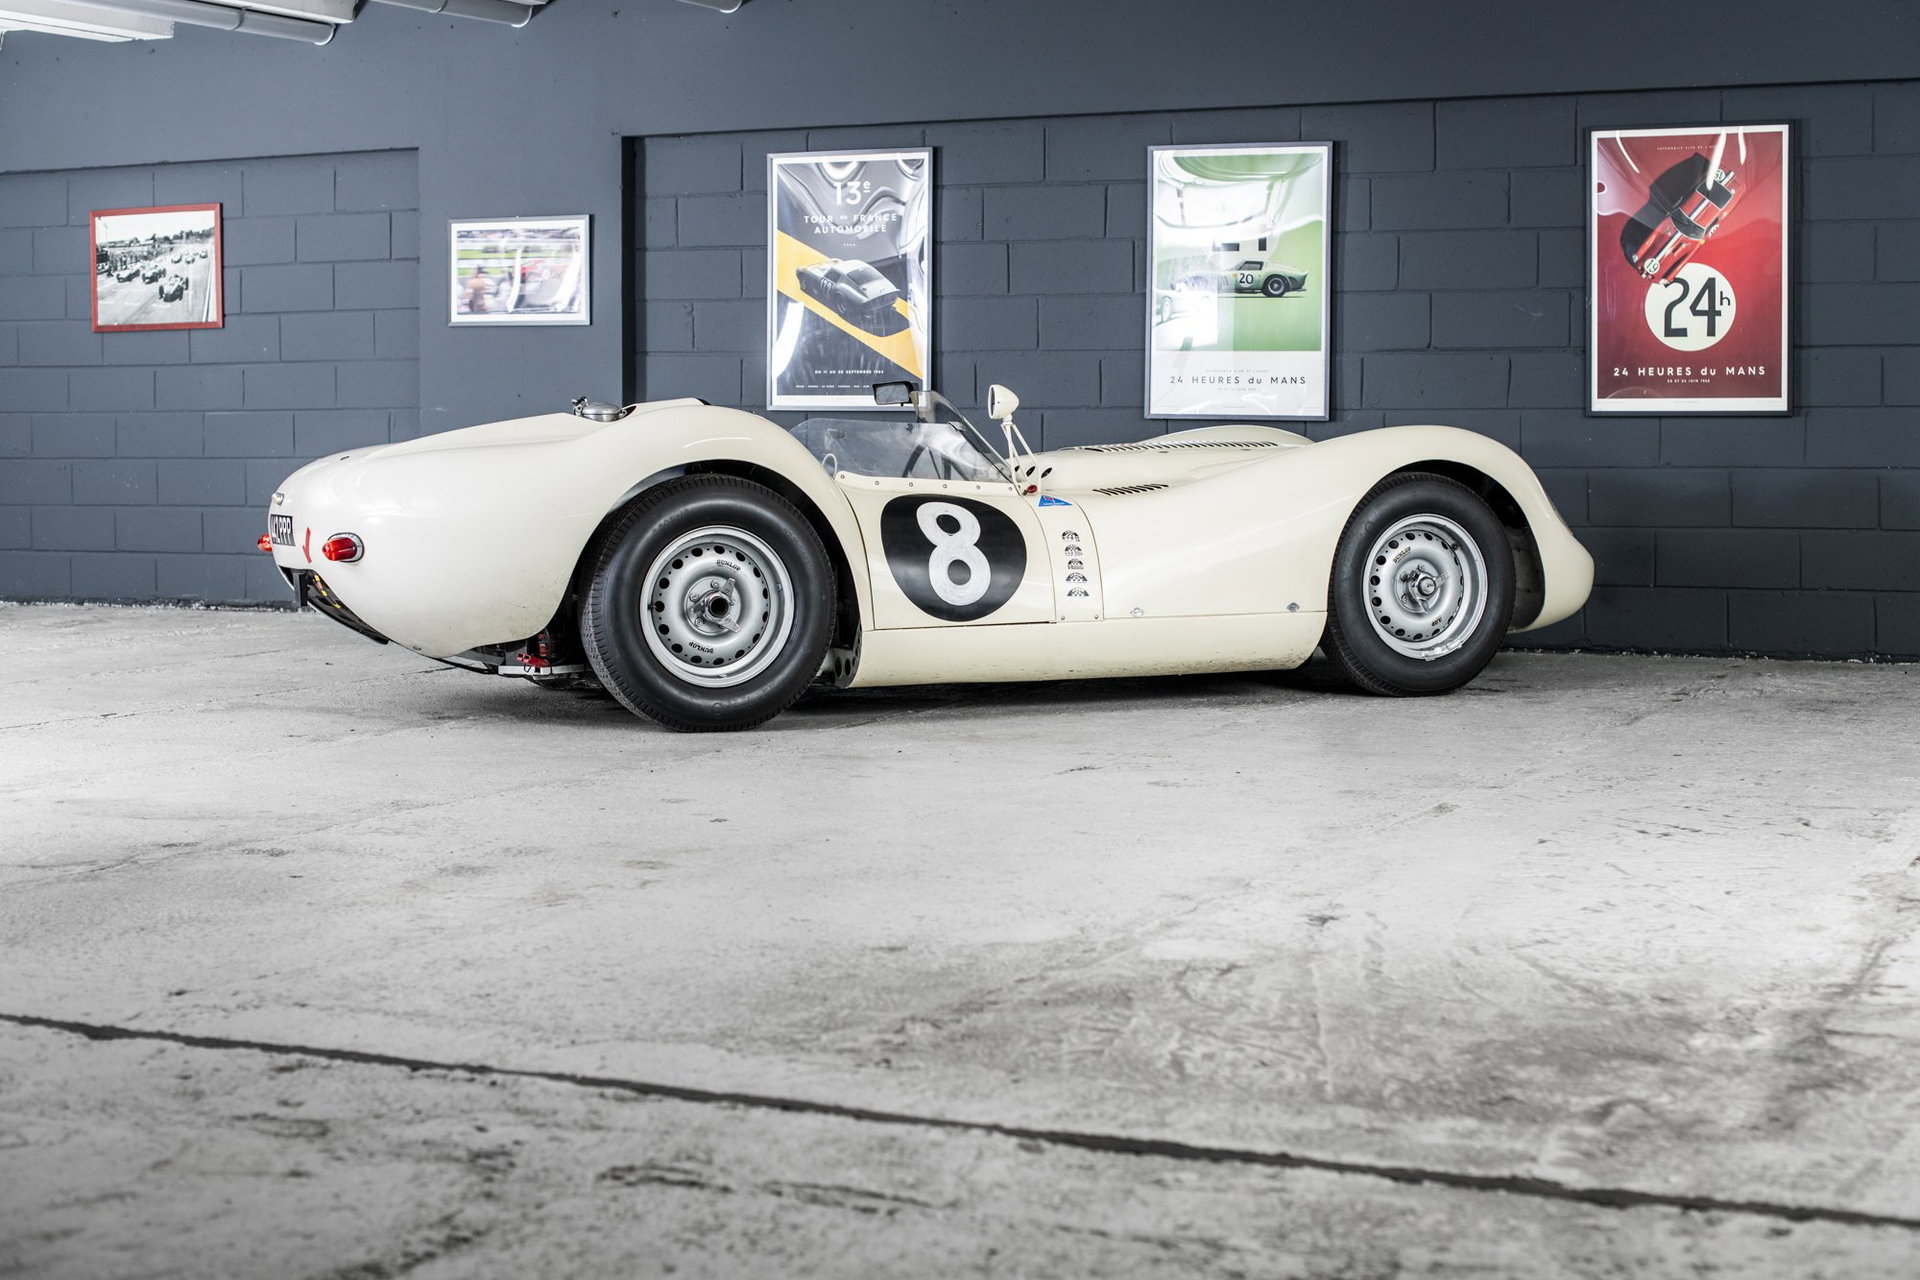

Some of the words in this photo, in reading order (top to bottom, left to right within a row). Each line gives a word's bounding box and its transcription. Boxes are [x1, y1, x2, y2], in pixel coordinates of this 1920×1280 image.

[833, 181, 871, 206] 13e
[803, 215, 833, 224] TOUR
[853, 213, 897, 222] FRANCE
[814, 224, 887, 234] AUTOMOBILE
[1239, 272, 1254, 285] 20
[1613, 367, 1629, 377] 24
[1637, 366, 1692, 376] HEURES
[1700, 366, 1717, 376] du
[1725, 365, 1766, 376] MANS
[1170, 376, 1183, 384] 24
[1191, 376, 1240, 384] HEURES
[1248, 376, 1262, 384] du
[1270, 376, 1306, 384] MANS
[916, 501, 991, 606] 8
[716, 559, 742, 571] DUNLOP
[689, 641, 714, 654] DUNLOP
